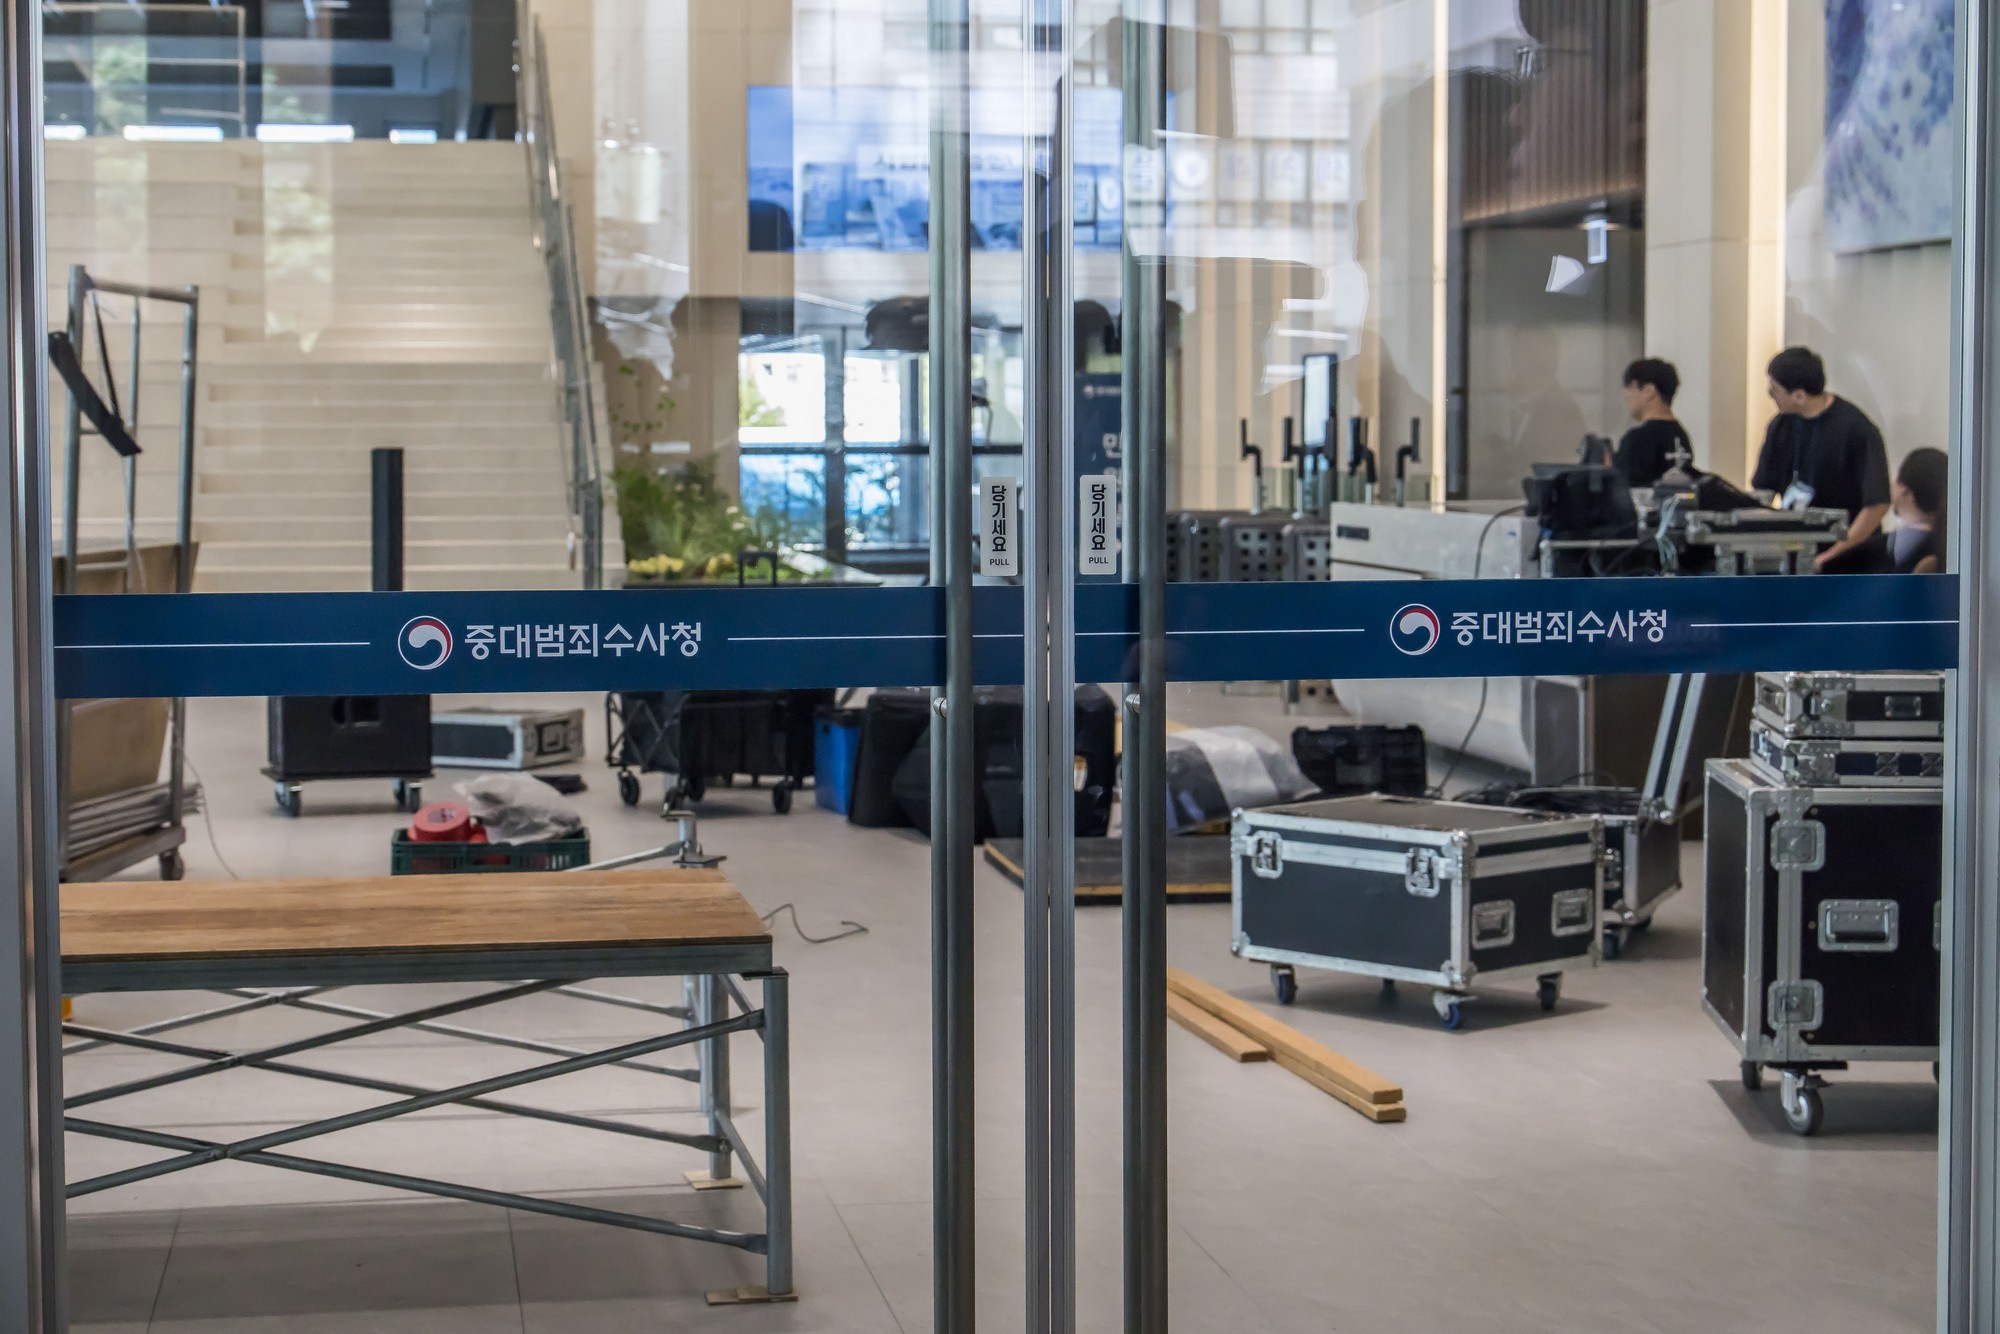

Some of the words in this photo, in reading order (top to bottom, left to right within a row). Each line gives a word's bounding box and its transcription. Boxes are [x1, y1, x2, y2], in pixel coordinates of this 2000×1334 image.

[991, 485, 1007, 552] 당기세요
[1091, 483, 1107, 551] 당기세요
[989, 558, 1010, 566] PULL
[1088, 556, 1109, 564] PULL
[464, 621, 702, 660] 중대범죄수사청
[1450, 608, 1667, 646] 중대범죄수사청
